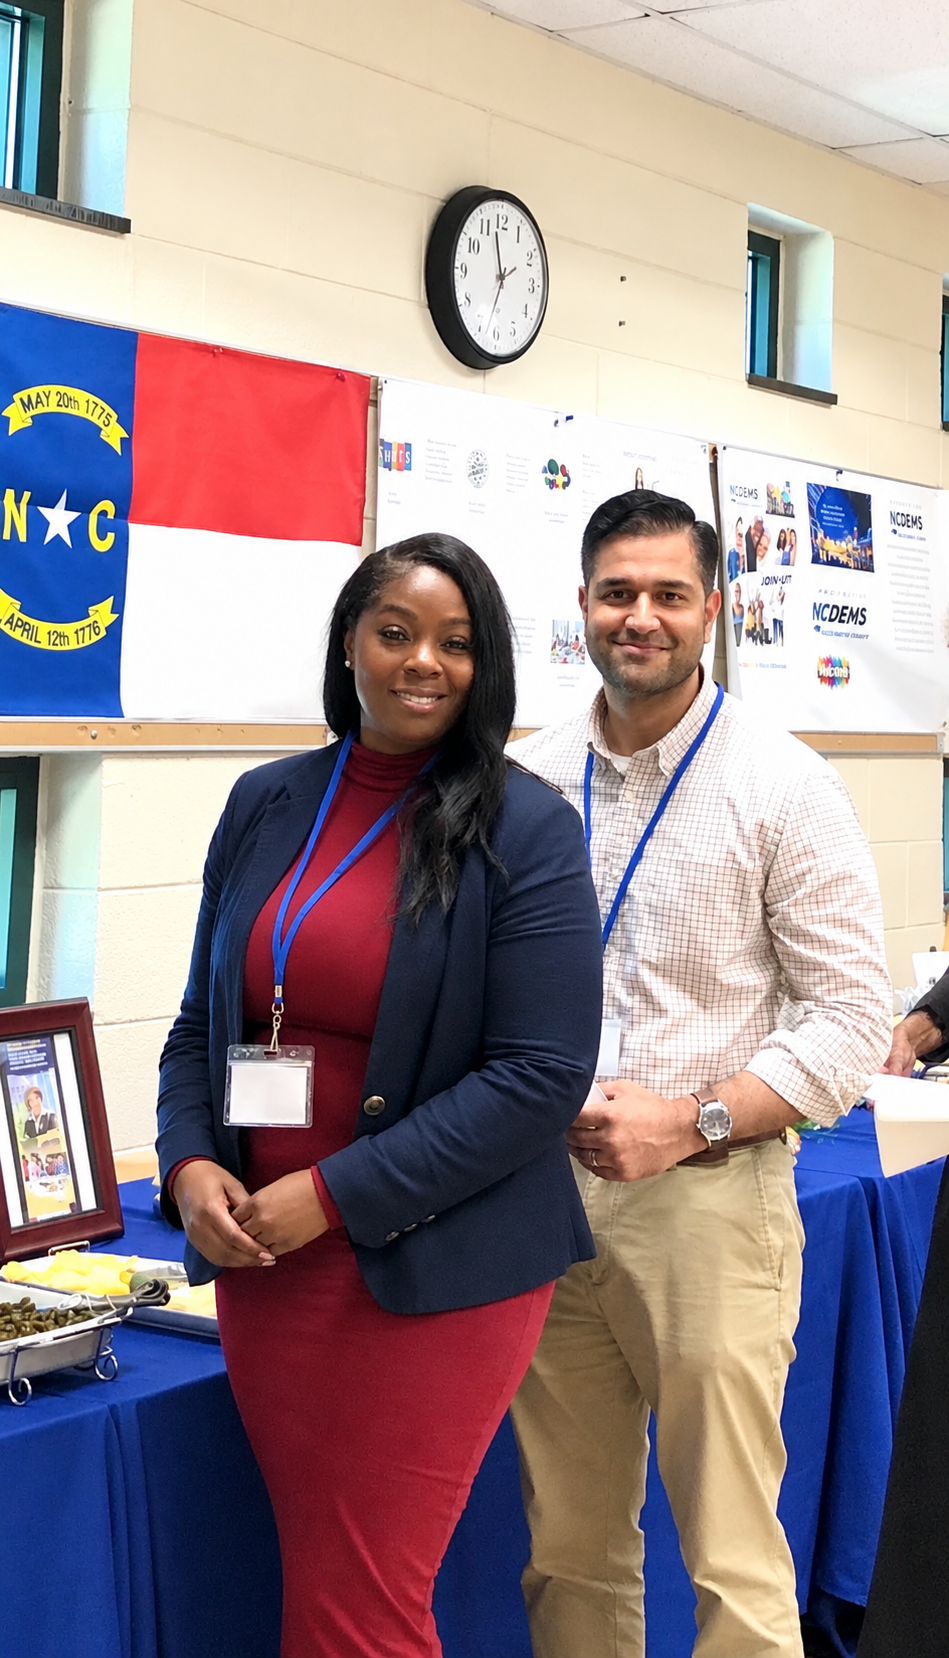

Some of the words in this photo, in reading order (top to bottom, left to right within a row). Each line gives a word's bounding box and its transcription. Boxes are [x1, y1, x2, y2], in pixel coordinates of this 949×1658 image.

[480, 218, 490, 236] 11
[496, 213, 508, 232] 12
[516, 225, 521, 243] 1
[468, 236, 480, 255] 10
[526, 250, 533, 267] 2
[460, 262, 468, 279] 9
[528, 278, 535, 295] 3
[464, 292, 472, 308] 8
[521, 303, 528, 318] 4
[492, 326, 500, 341] 6
[509, 321, 516, 337] 5
[19, 390, 51, 414] MAY
[56, 391, 80, 411] 20th
[85, 398, 113, 427] 1775
[729, 484, 759, 500] NCDEMS
[2, 488, 32, 542] N
[89, 499, 116, 552] C
[889, 510, 923, 530] NCDEMS
[812, 601, 867, 626] NCDEMS
[4, 612, 42, 644] APRIL
[46, 630, 70, 646] 12th
[74, 620, 101, 645] 1776
